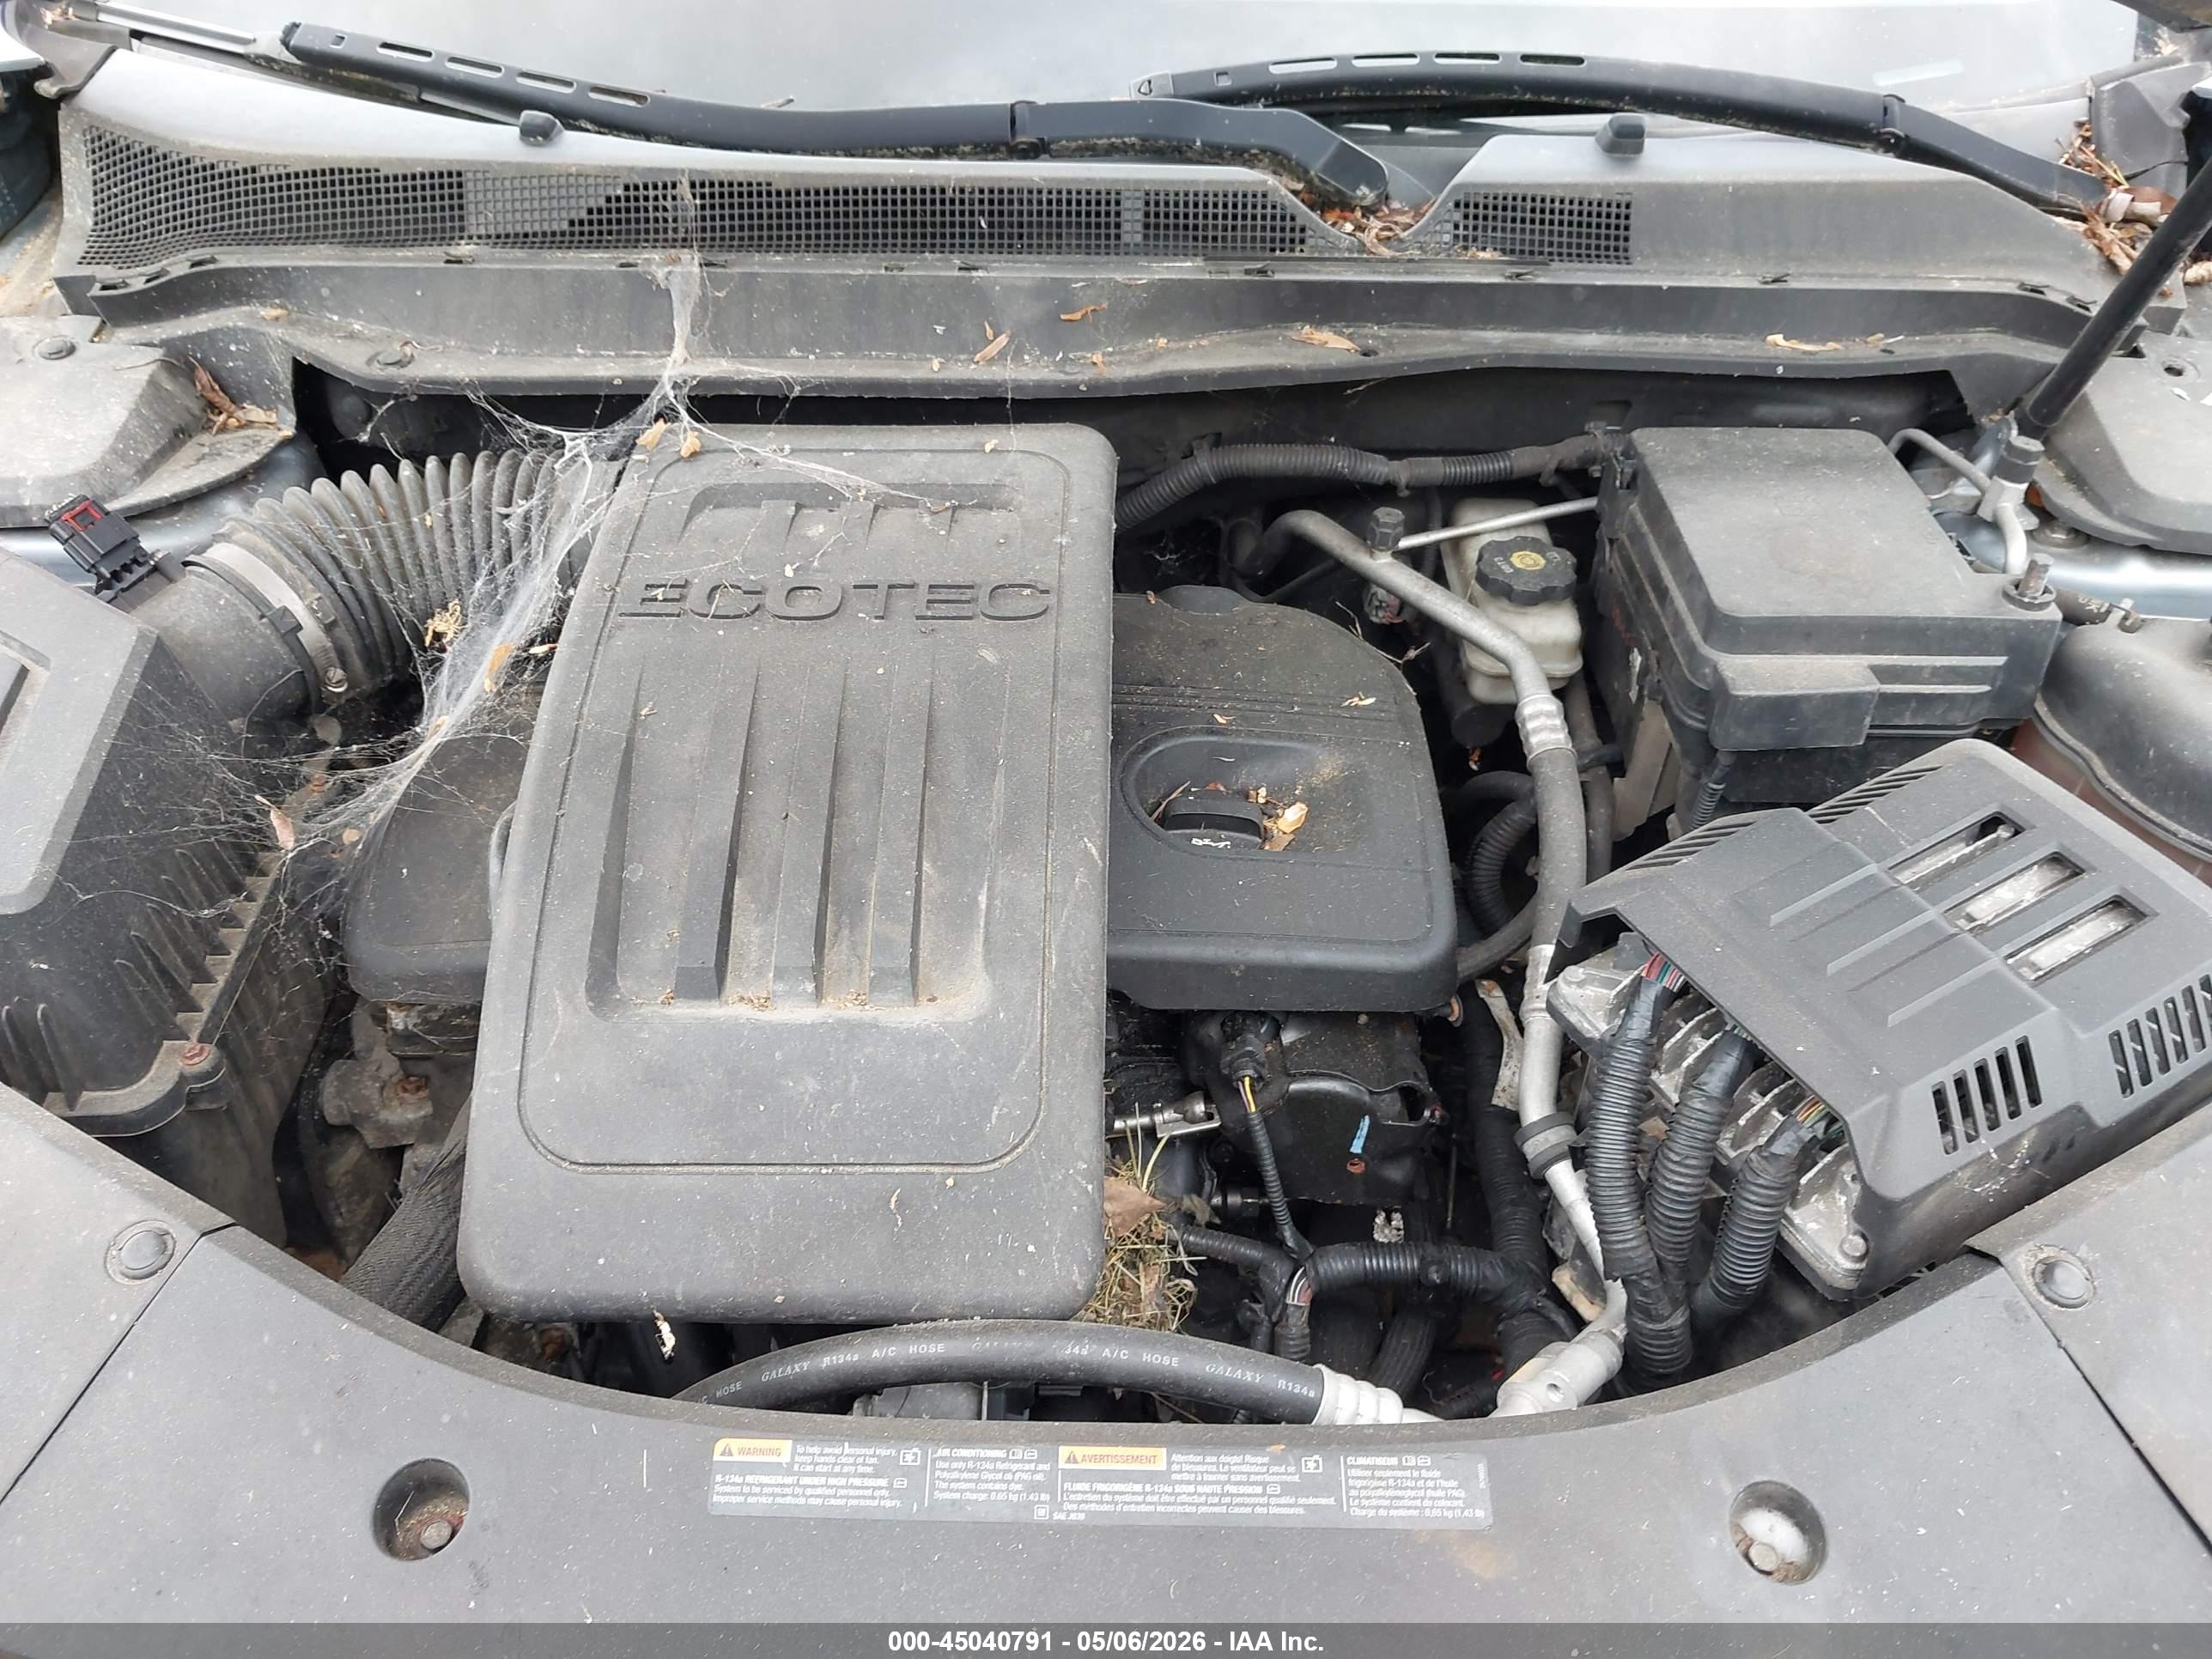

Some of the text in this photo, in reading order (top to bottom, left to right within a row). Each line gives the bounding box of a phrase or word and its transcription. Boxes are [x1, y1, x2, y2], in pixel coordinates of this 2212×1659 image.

[618, 583, 1050, 621] ECOTEC
[716, 1381, 743, 1397] HOSE
[761, 1361, 811, 1382] GALAXY
[823, 1353, 860, 1367] R134a
[872, 1346, 896, 1358] A/C
[909, 1343, 945, 1354] HOSE
[1102, 1348, 1128, 1359] A/C
[1143, 1352, 1180, 1366] HOSE
[1206, 1364, 1264, 1382] GALAXY
[1277, 1379, 1316, 1398] R134a
[738, 1447, 782, 1457] WARNING
[805, 1445, 822, 1456] help
[823, 1447, 842, 1455] avoid
[843, 1447, 875, 1457] personal
[951, 1449, 1008, 1459] CONDITIONING
[794, 1454, 812, 1464] keep
[813, 1455, 836, 1464] hands
[1080, 1455, 1158, 1465] AVERTISSEMENT
[1170, 1453, 1204, 1463] Attention
[1244, 1455, 1270, 1465] Risque
[1346, 1456, 1399, 1466] CLIMATISEUR
[842, 1466, 856, 1474] any
[935, 1460, 1051, 1473] Use only R-134a Refrigerant and
[1170, 1462, 1182, 1472] de
[1219, 1463, 1230, 1472] Le
[1230, 1464, 1268, 1473] ventilateur
[1268, 1465, 1286, 1474] peut
[981, 1470, 1003, 1482] Glycol
[1203, 1473, 1229, 1481] tourner
[1230, 1474, 1249, 1482] sans
[1347, 1468, 1442, 1478] Utiliser seulement le fluide
[744, 1475, 799, 1486] REFRIGERANT
[799, 1476, 827, 1486] UNDER
[827, 1477, 848, 1486] HIGH
[848, 1477, 890, 1487] PRESSURE
[934, 1480, 949, 1489] The
[949, 1482, 976, 1492] system
[976, 1482, 1008, 1492] contains
[1388, 1479, 1416, 1488] R-134a
[1416, 1479, 1425, 1487] et
[1425, 1479, 1436, 1488] de
[714, 1485, 741, 1495] System
[742, 1486, 750, 1494] to
[762, 1486, 793, 1495] serviced
[793, 1486, 805, 1498] by
[805, 1486, 836, 1498] qualified
[836, 1488, 873, 1497] personnel
[1063, 1482, 1092, 1492] FLUIDE
[1174, 1484, 1196, 1494] SOUS
[1196, 1484, 1224, 1494] HAUTE
[1224, 1484, 1263, 1495] PRESSION
[1348, 1488, 1359, 1498] au
[713, 1494, 746, 1504] Improper
[746, 1496, 774, 1504] service
[775, 1496, 806, 1505] methods
[807, 1498, 823, 1507] may
[824, 1498, 847, 1506] cause
[848, 1498, 879, 1508] personal
[933, 1490, 961, 1501] System
[1008, 1492, 1019, 1503] kg
[1102, 1493, 1113, 1503] du
[1113, 1494, 1145, 1504] système
[1145, 1494, 1159, 1504] doit
[1207, 1496, 1220, 1505] par
[1231, 1497, 1268, 1506] personnel
[1268, 1496, 1296, 1507] qualifié
[1063, 1502, 1079, 1511] Des
[1079, 1503, 1115, 1512] méthodes
[1156, 1504, 1197, 1514] incorrectes
[1197, 1505, 1227, 1515] peuvent
[1227, 1505, 1253, 1514] causer
[1254, 1505, 1268, 1515] des
[1349, 1498, 1359, 1506] Le
[1359, 1498, 1391, 1509] système
[1391, 1498, 1422, 1508] contient
[1422, 1499, 1432, 1508] du
[1349, 1507, 1376, 1518] Charge
[1377, 1508, 1389, 1517] du
[1389, 1508, 1419, 1519] système
[1443, 1508, 1454, 1519] kg
